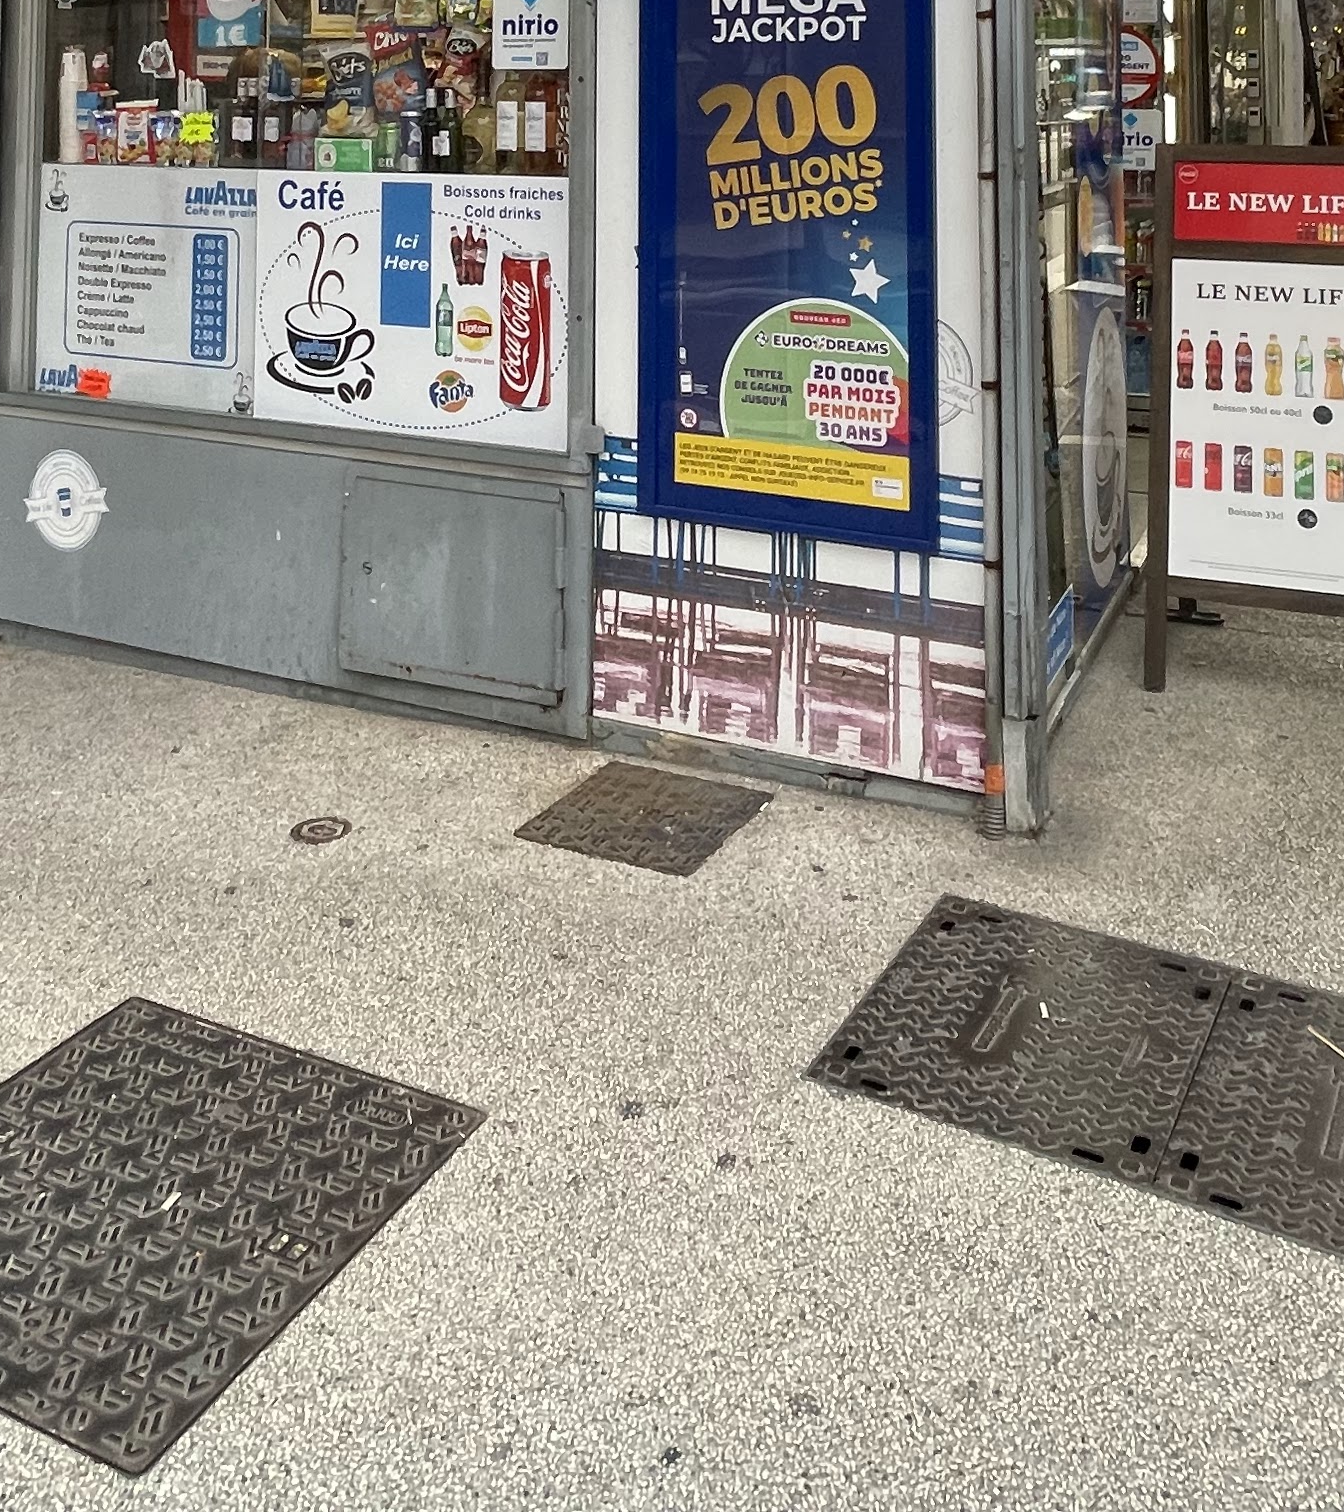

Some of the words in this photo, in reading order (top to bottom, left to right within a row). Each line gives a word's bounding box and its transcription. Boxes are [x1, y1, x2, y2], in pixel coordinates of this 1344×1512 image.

[502, 13, 559, 36] nirio
[711, 15, 866, 45] JACKPOT
[697, 64, 877, 167] 200
[708, 148, 884, 199] MILLIONS
[277, 178, 345, 213] Café
[443, 184, 506, 200] Boissons
[509, 185, 565, 202] fraiches
[1186, 191, 1222, 212] LE
[1228, 193, 1295, 214] NEW
[184, 204, 210, 216] Café
[212, 208, 226, 217] en
[464, 204, 495, 219] Cold
[499, 204, 542, 221] drinks
[394, 232, 419, 251] Ici
[383, 253, 430, 274] Here
[1196, 283, 1227, 301] LE
[1234, 285, 1295, 306] NEW
[459, 320, 491, 336] Lipton
[39, 363, 79, 389] LAVA
[742, 367, 784, 381] TENTEZ
[813, 364, 836, 380] 20
[840, 366, 890, 385] 000€
[429, 380, 475, 409] Fanta
[733, 380, 748, 391] DE
[748, 381, 793, 395] GAGNER
[807, 382, 844, 399] PAR
[847, 385, 896, 405] MOIS
[808, 402, 895, 424] PENDANT
[1212, 402, 1248, 415] Boisson
[1248, 403, 1268, 416] 50cl
[1269, 407, 1281, 417] ou
[1282, 406, 1303, 419] 40cl
[819, 421, 842, 438] 30
[845, 424, 883, 443] ANS
[1227, 506, 1264, 520] Boisson
[1264, 508, 1284, 521] 33cl
